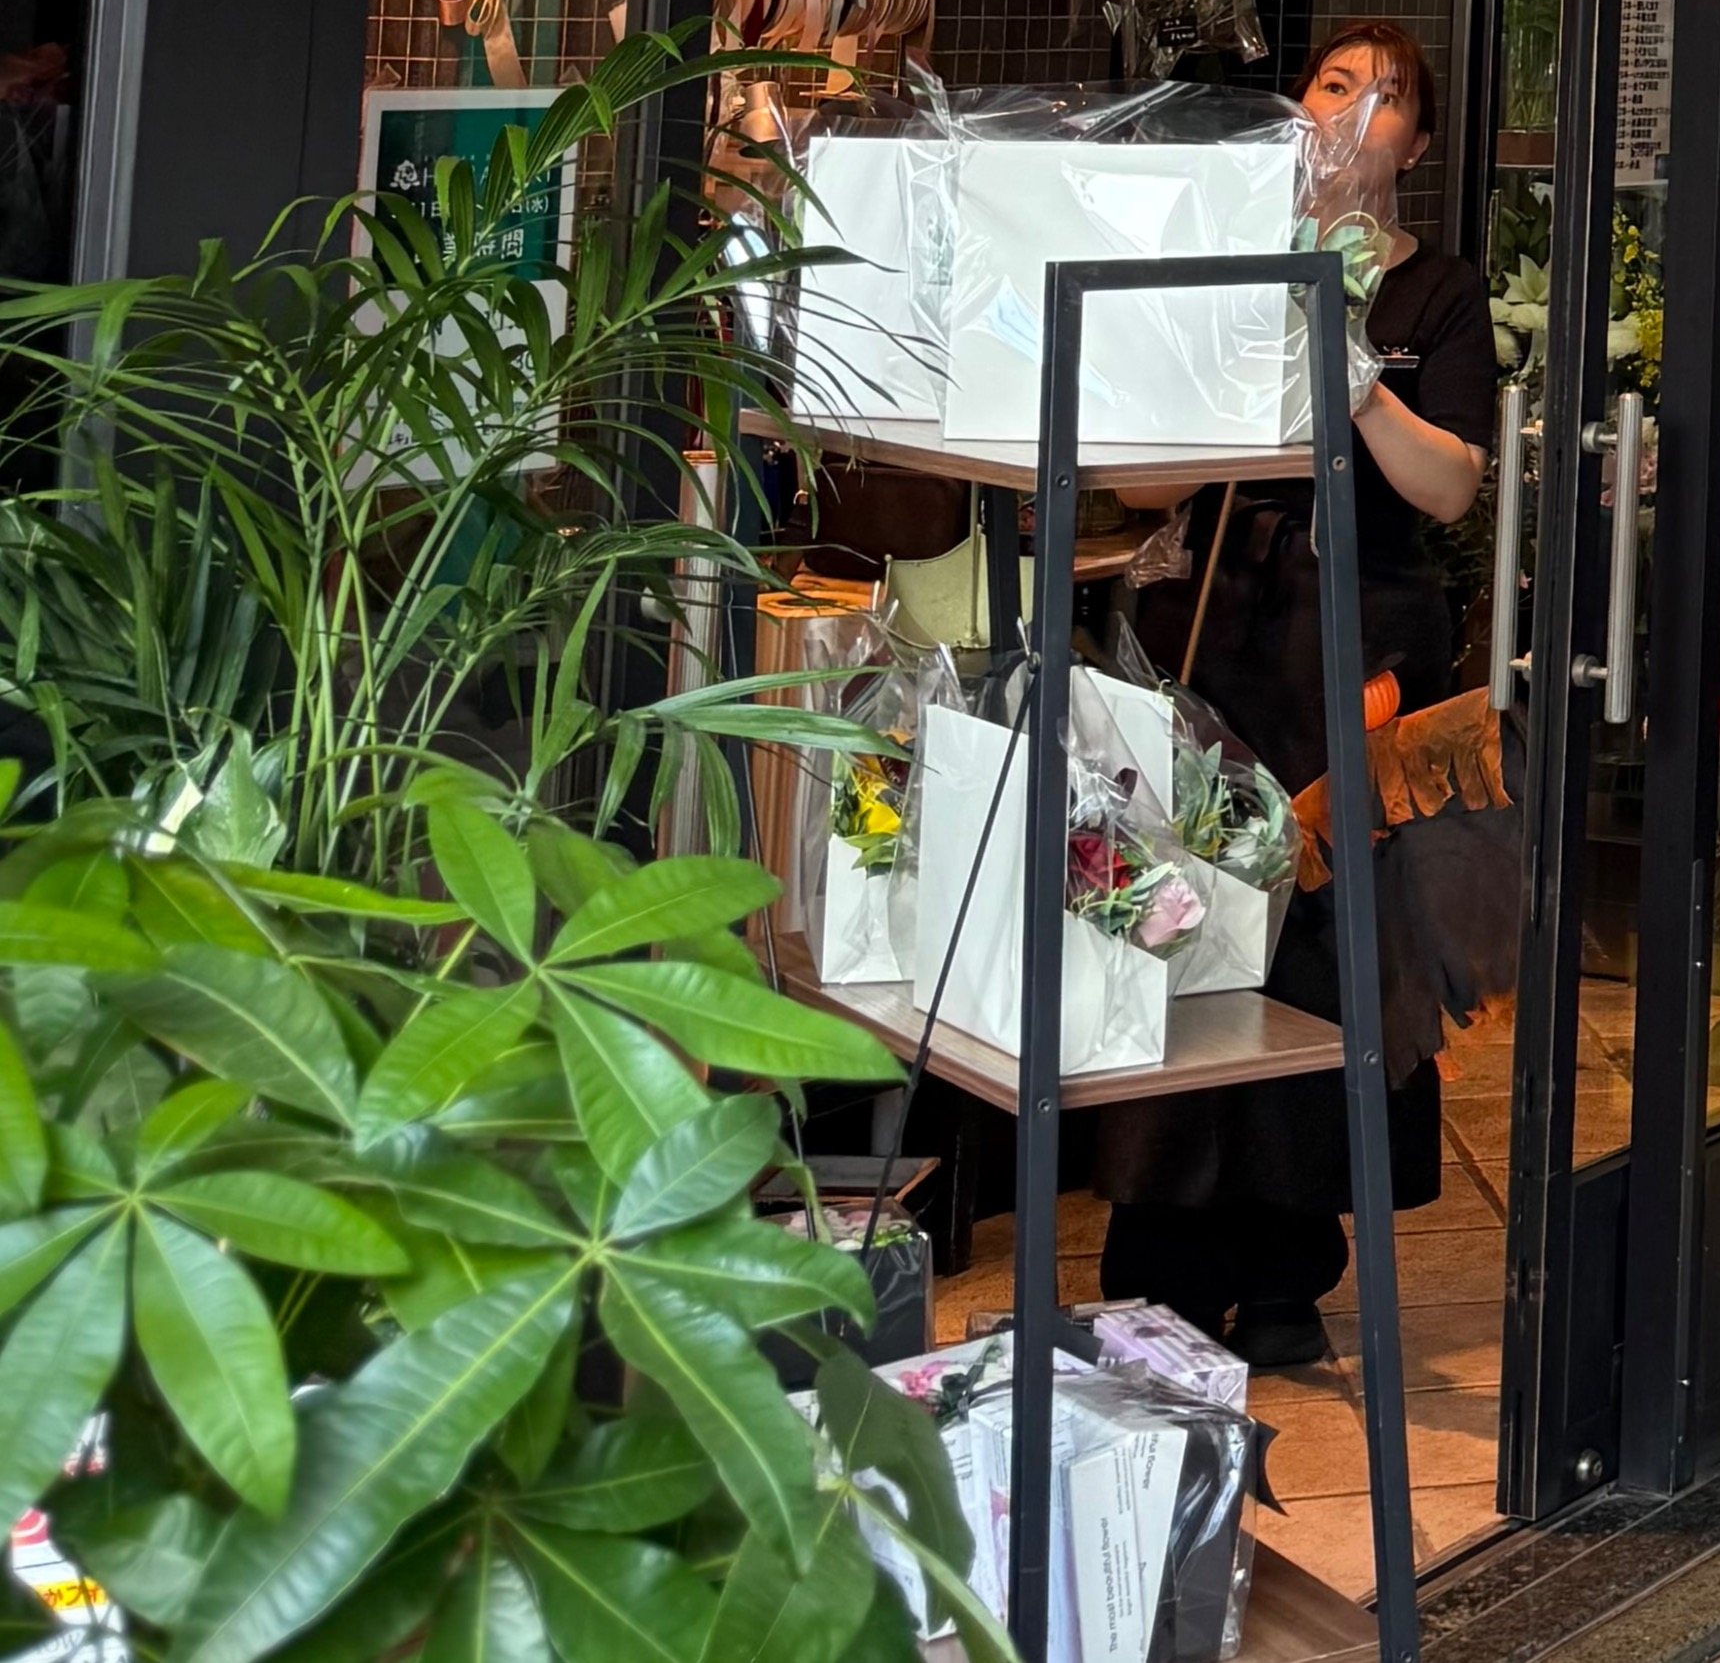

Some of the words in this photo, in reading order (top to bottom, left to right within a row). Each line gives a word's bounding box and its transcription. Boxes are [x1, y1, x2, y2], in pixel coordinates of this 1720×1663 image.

[1099, 1516, 1112, 1550] flower
[1102, 1551, 1115, 1597] beautiful
[1106, 1600, 1117, 1628] most
[1108, 1630, 1118, 1653] The
